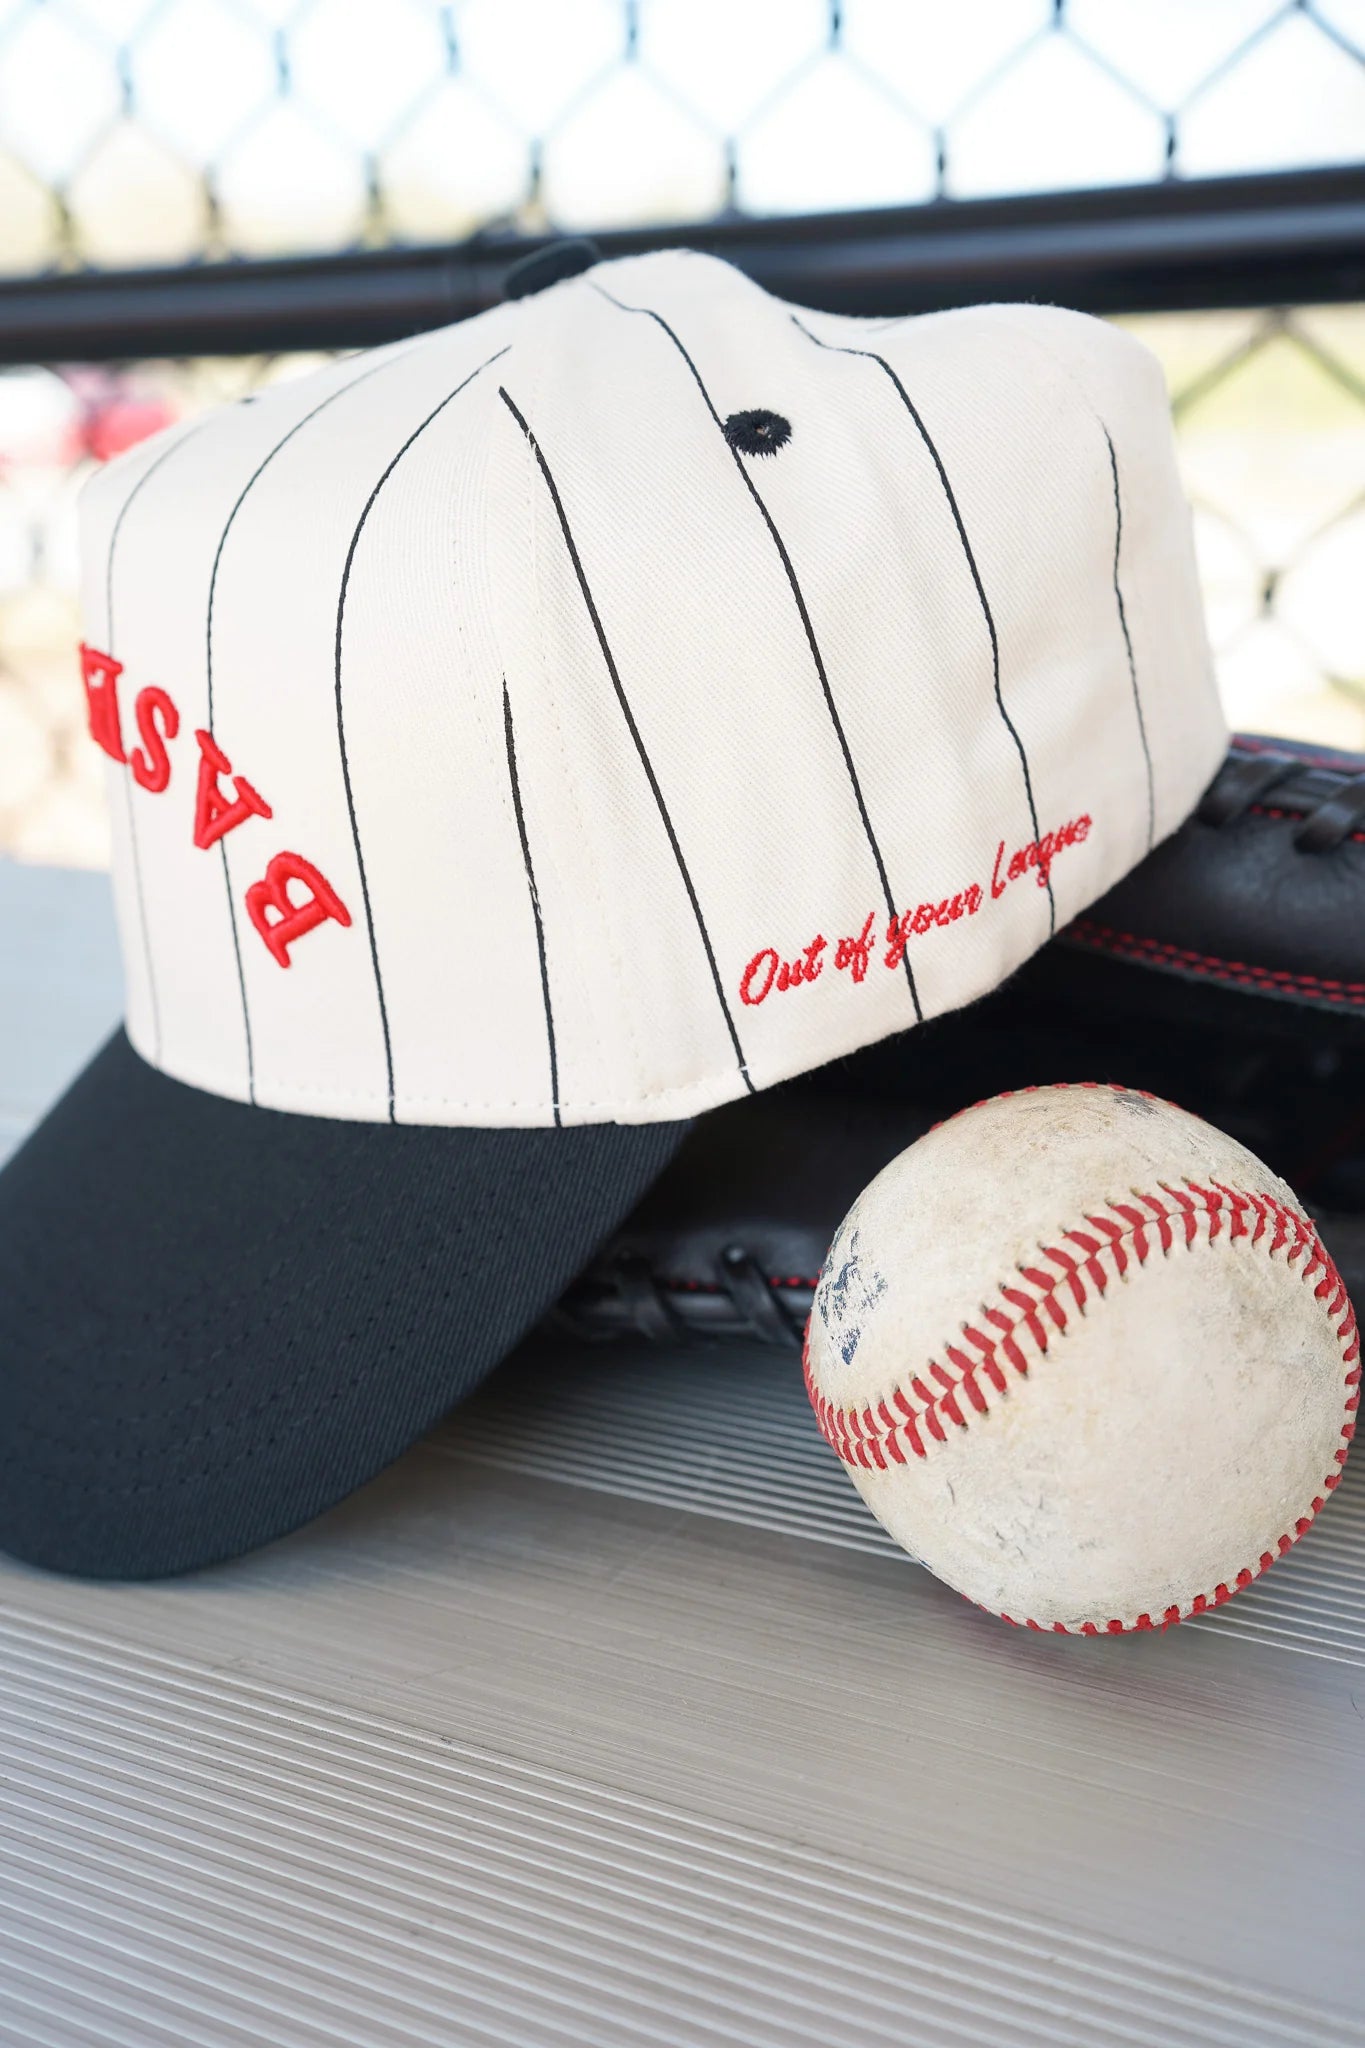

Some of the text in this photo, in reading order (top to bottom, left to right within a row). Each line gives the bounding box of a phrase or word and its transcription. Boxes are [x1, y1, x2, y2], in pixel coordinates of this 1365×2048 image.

[739, 813, 1093, 1006] Out of your League
